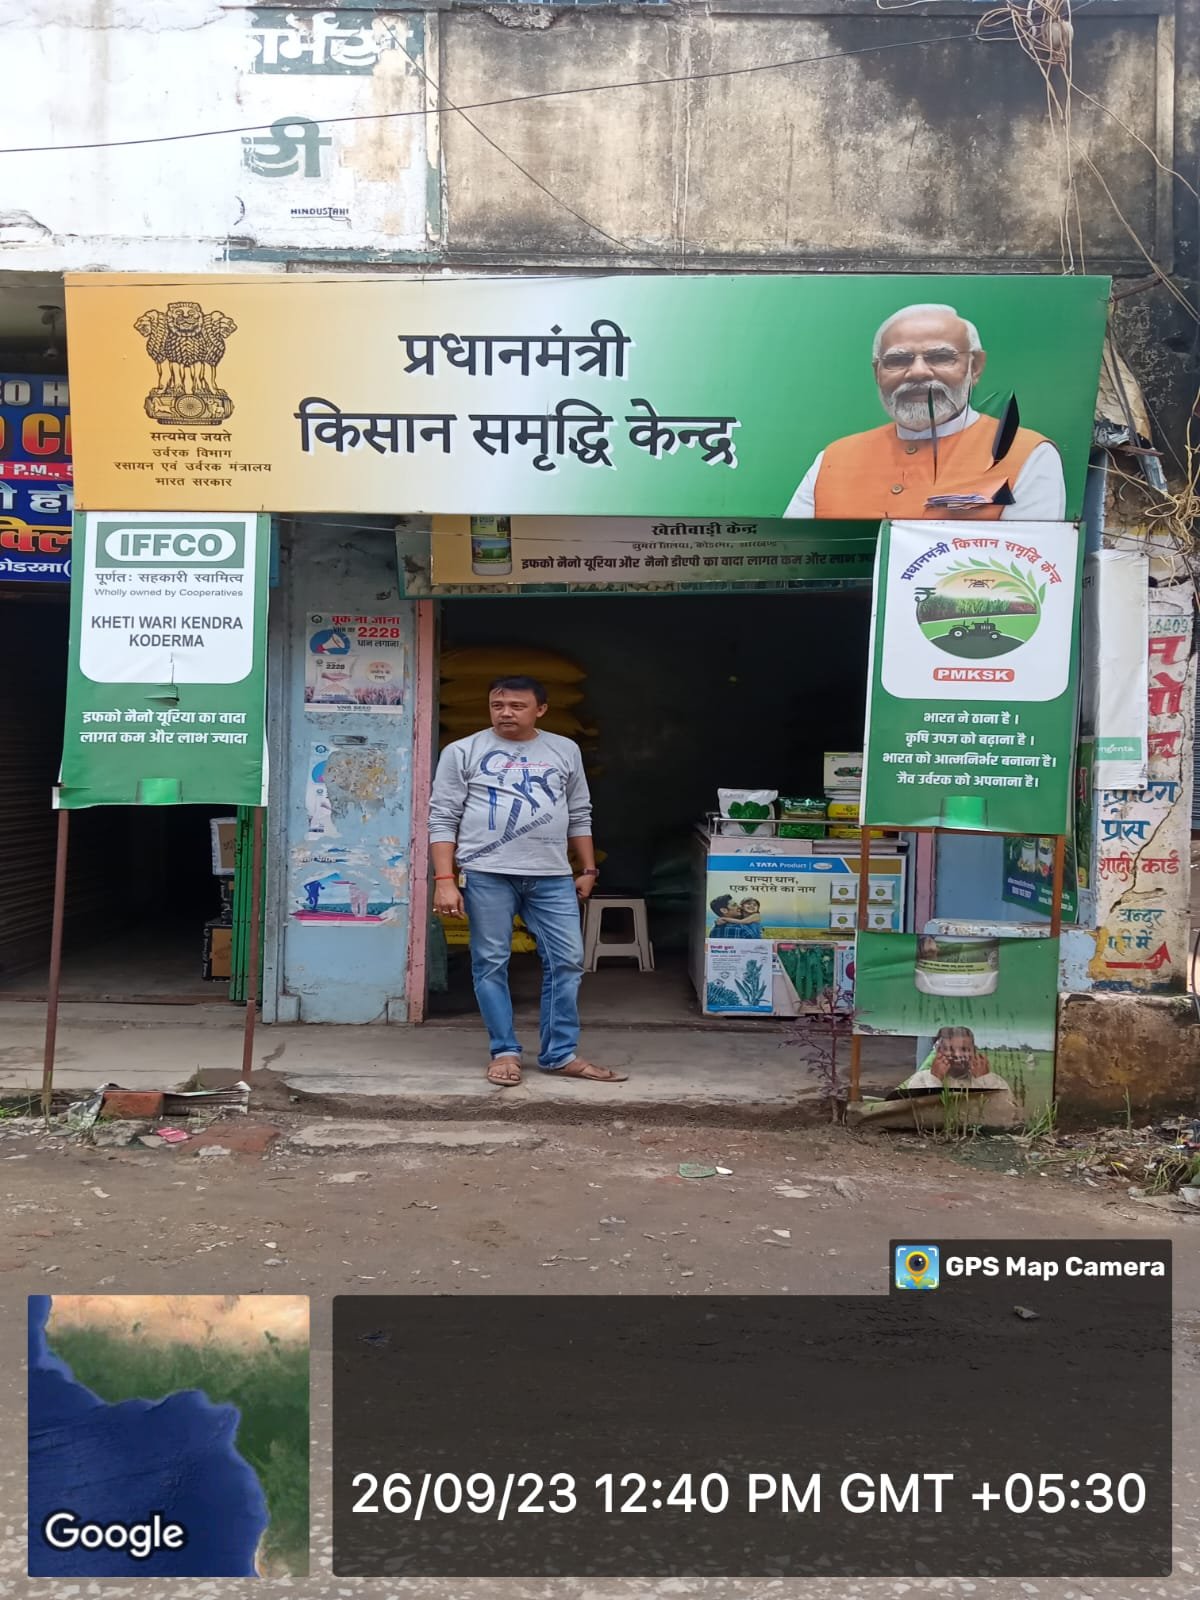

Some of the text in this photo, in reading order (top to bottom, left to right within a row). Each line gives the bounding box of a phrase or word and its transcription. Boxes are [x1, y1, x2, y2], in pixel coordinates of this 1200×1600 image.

[290, 207, 349, 221] HINDUSTANI
[398, 318, 632, 376] प्रधानमंत्री
[0, 379, 69, 407] O H
[150, 429, 232, 442] सत्यमेव जयते
[293, 396, 738, 471] किसान समृद्धि केन्द्र
[152, 446, 232, 458] उर्वरक विभाग
[114, 460, 272, 472] रसायन एवं उर्वरक मंत्रालय
[155, 477, 232, 487] भारत सरकार
[120, 533, 223, 556] IFFCO
[521, 556, 554, 569] इफको
[557, 555, 581, 569] नैनो
[584, 556, 617, 571] यूरिया
[619, 555, 640, 568] और
[644, 555, 668, 567] नैनो
[671, 554, 700, 567] डीएपी
[703, 556, 719, 567] का
[721, 556, 743, 566] वादा
[747, 555, 778, 566] लागत
[805, 552, 826, 565] और
[901, 543, 950, 582] प्रधानमंत्री
[952, 538, 998, 550] किसान
[1005, 540, 1044, 565] समृद्धि
[138, 570, 188, 583] सहकारी
[194, 572, 244, 584] स्वामित्व
[94, 588, 243, 598] Wholly owned by Cooperatives
[91, 616, 243, 630] KHETI WARI KENDRA
[358, 627, 400, 639] 2228
[129, 634, 204, 647] KODERMA
[937, 669, 1010, 681] PMKSK
[82, 708, 246, 727] इफको नैनो यूरिया का वादा
[923, 712, 955, 724] भारत
[958, 711, 970, 724] ने
[971, 713, 999, 725] ठाना
[1001, 711, 1011, 724] है
[80, 728, 248, 745] लागत कम और लाभ ज्यादा
[905, 730, 929, 747] कृषि
[931, 733, 957, 745] उपज
[960, 731, 976, 745] को
[978, 733, 1015, 747] बढ़ाना
[1017, 731, 1026, 746] है
[882, 751, 1057, 768] भारत को आत्मनिर्भर बनाना है।
[897, 771, 1039, 788] जैव उर्वरक को अपनाना है।
[1099, 851, 1132, 882] शादी
[1141, 850, 1181, 874] कार्ड
[730, 885, 748, 893] एक
[750, 883, 777, 893] भरोसे
